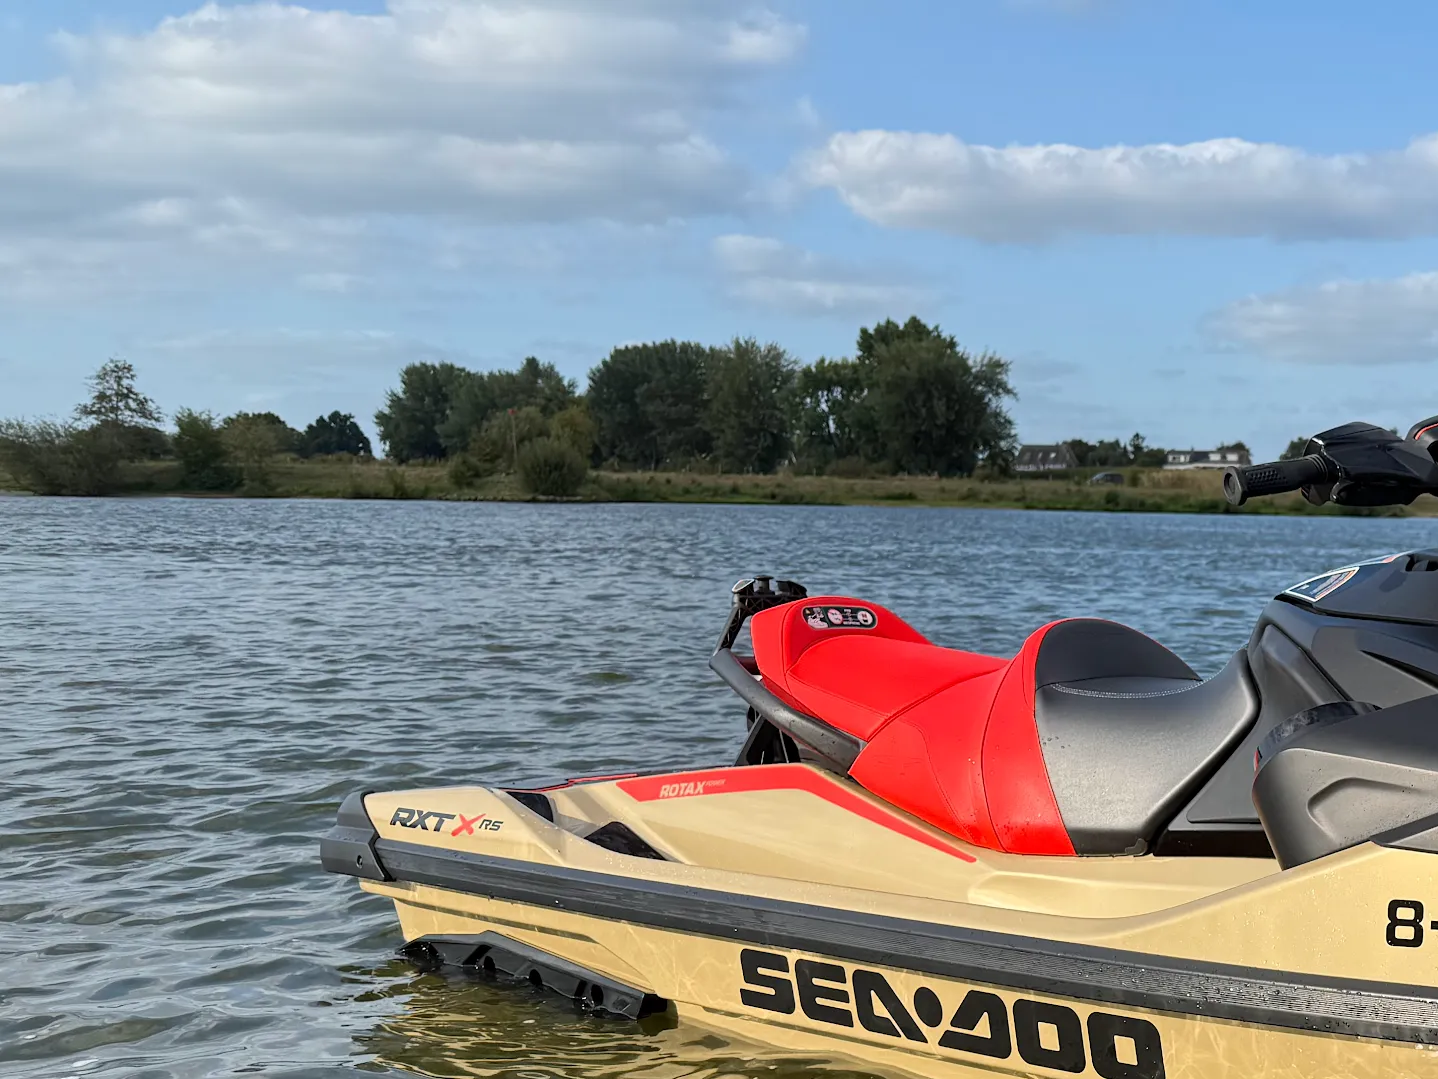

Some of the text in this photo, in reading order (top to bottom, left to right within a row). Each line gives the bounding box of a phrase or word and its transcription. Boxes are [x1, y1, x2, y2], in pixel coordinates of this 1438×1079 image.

[659, 781, 706, 798] ROTAX
[390, 807, 504, 837] RXT X RS
